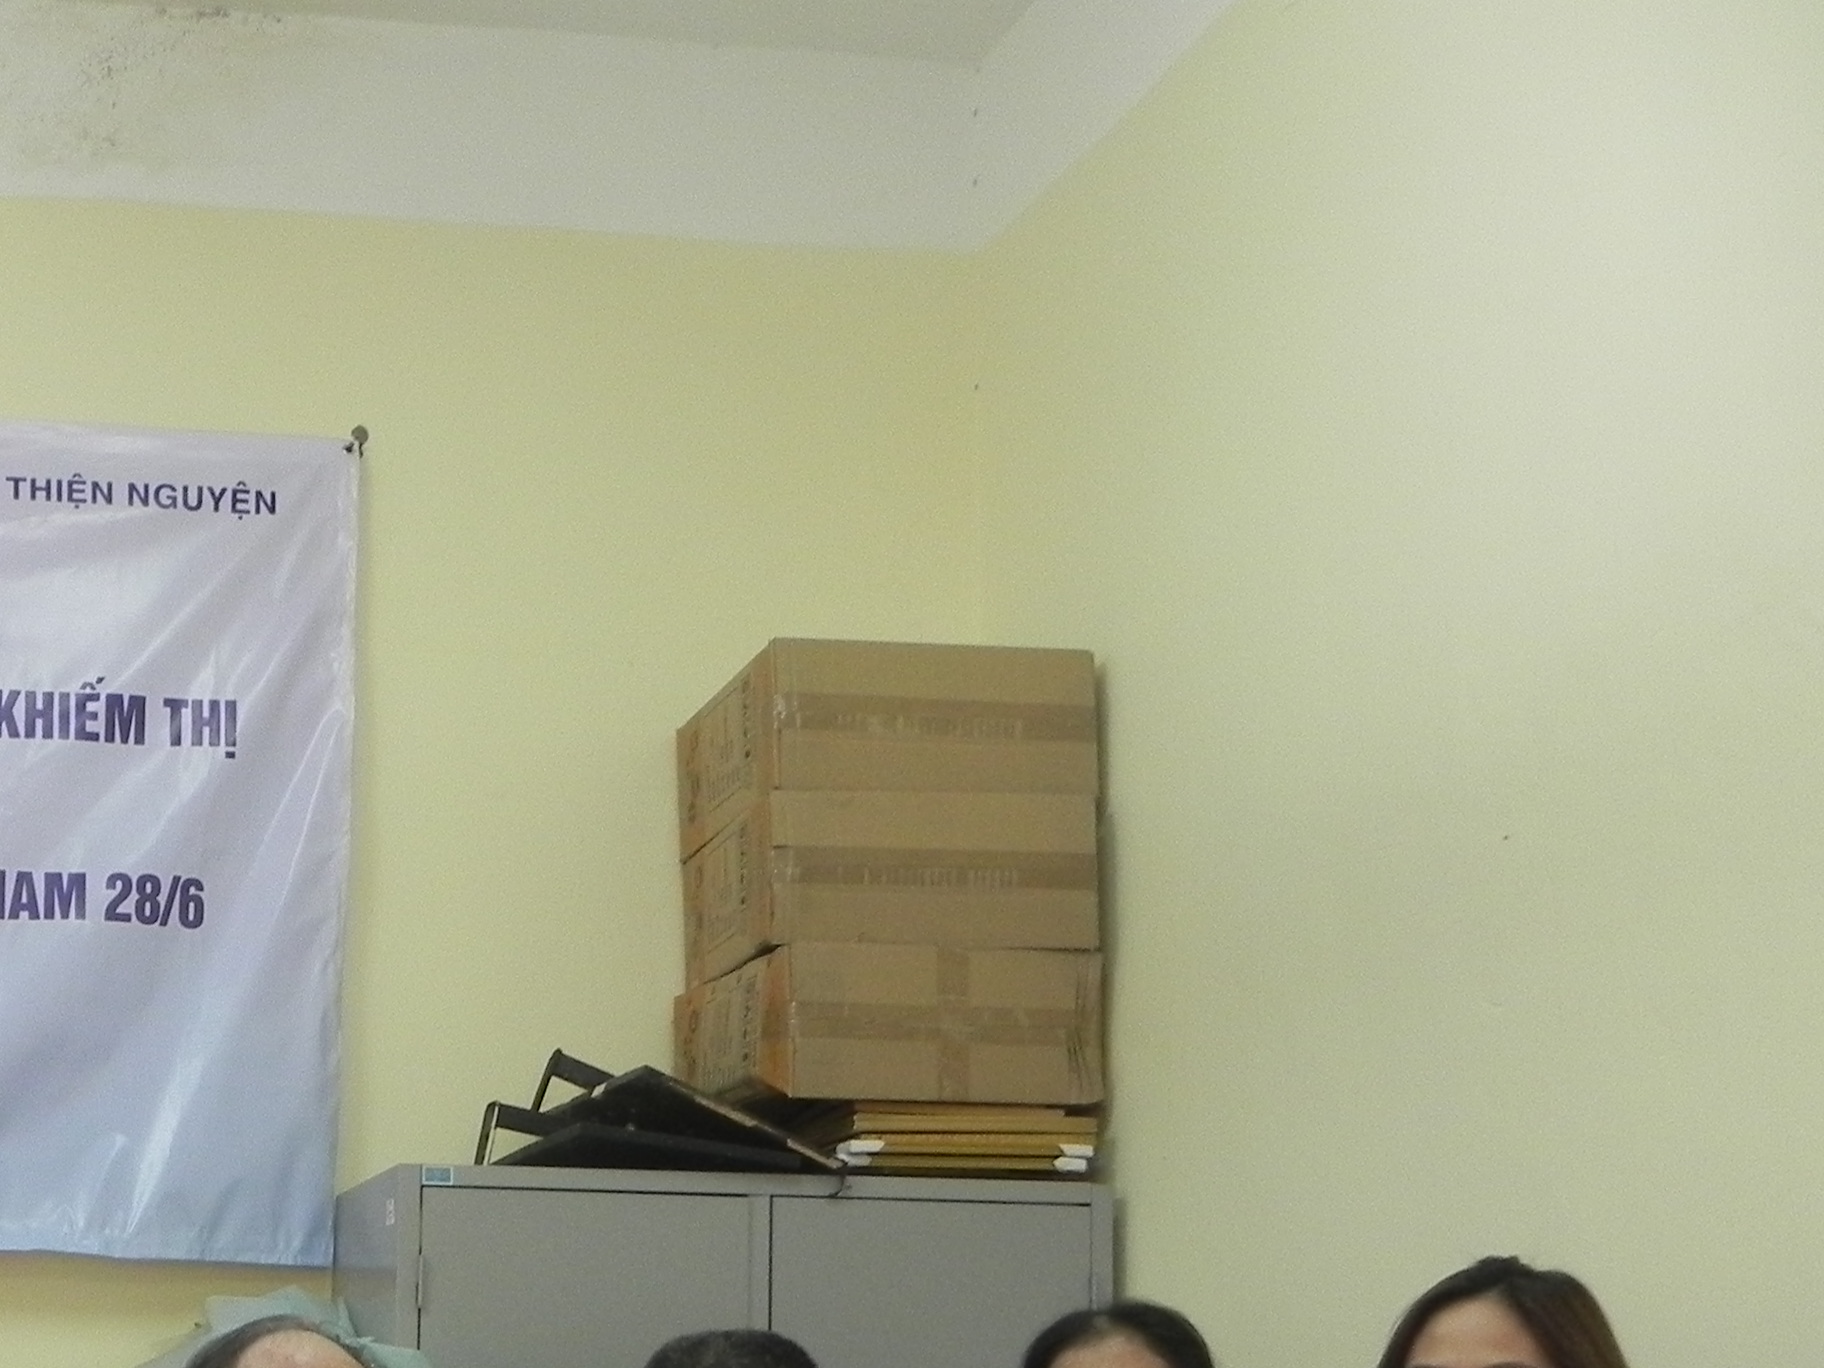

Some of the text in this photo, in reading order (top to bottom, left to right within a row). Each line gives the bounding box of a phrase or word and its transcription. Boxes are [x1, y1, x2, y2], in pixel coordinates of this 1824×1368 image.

[5, 473, 113, 509] THIỆN
[128, 480, 277, 520] NGUYỆN
[163, 697, 237, 760] THỊ
[104, 872, 205, 930] 28/6
